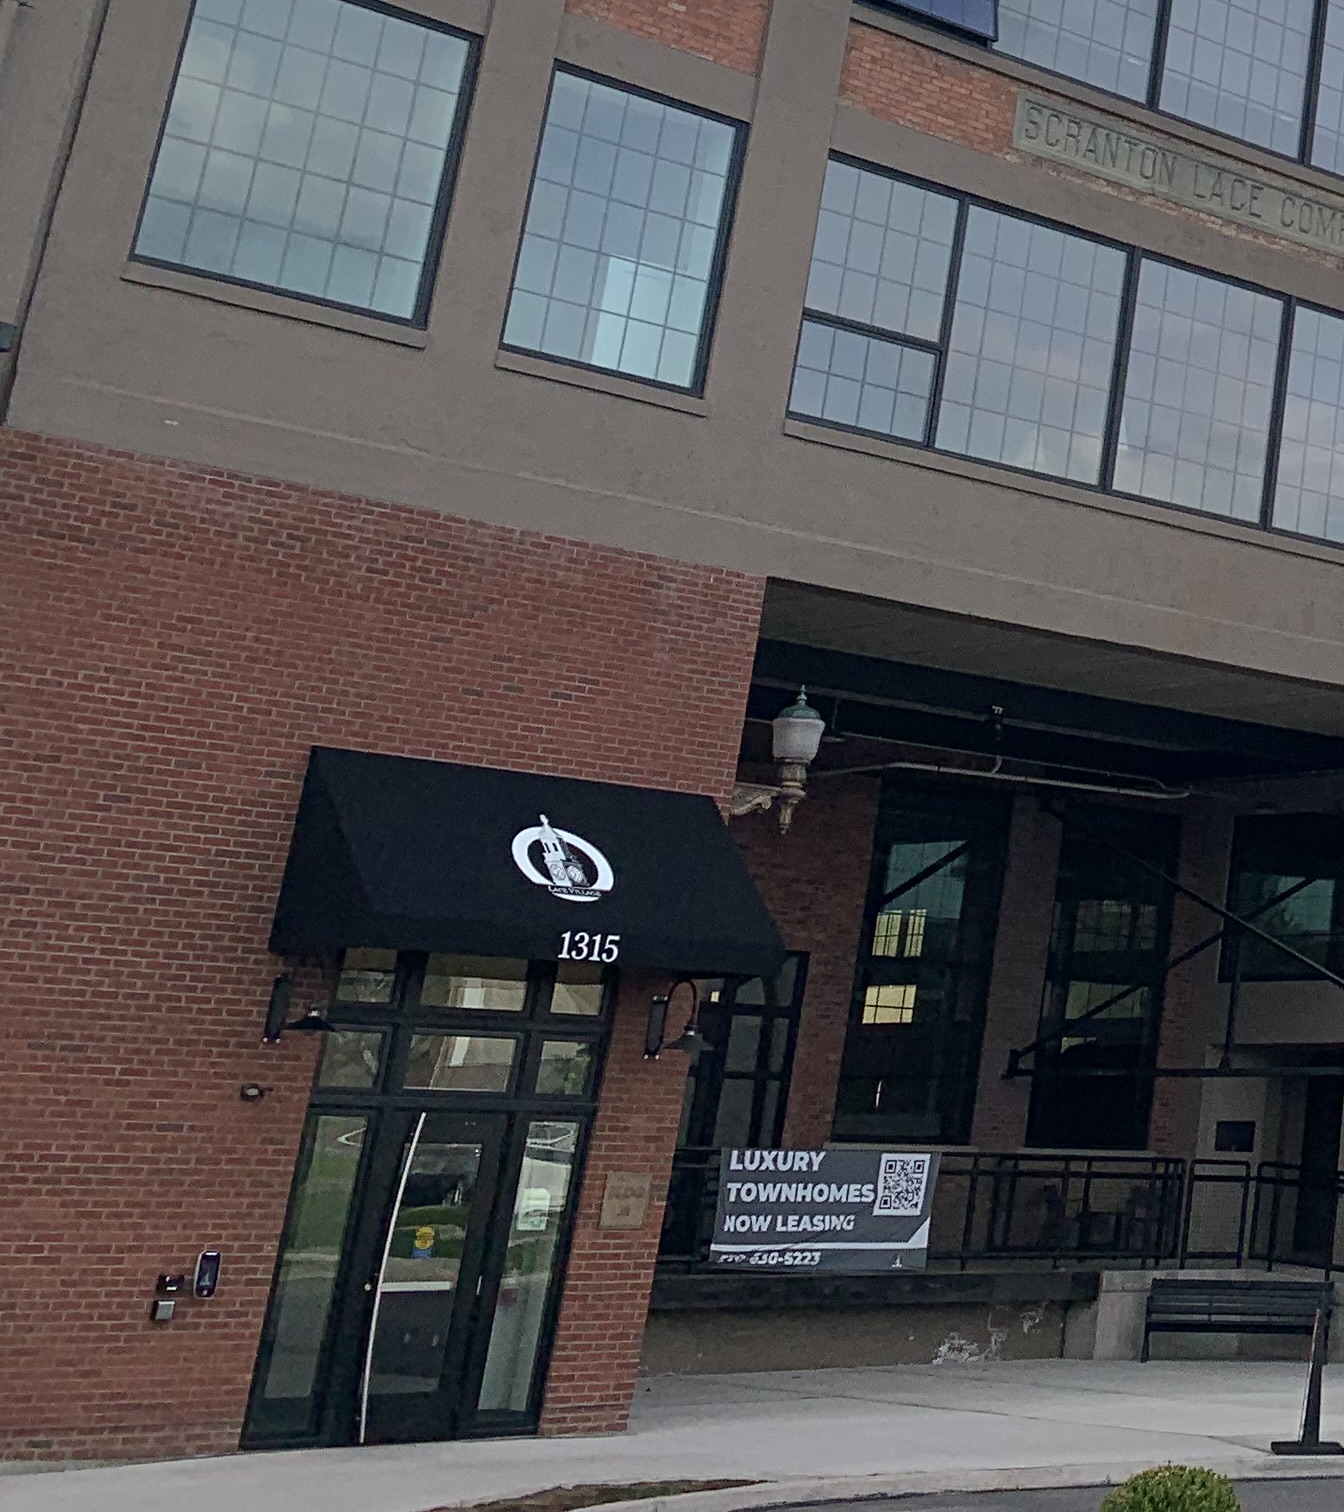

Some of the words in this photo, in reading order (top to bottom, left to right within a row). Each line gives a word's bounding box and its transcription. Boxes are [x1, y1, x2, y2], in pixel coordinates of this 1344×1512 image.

[1024, 105, 1178, 188] SCRANTON
[1194, 159, 1266, 219] LACE
[557, 930, 621, 963] 1315
[729, 1149, 826, 1172] LUXURY
[726, 1182, 876, 1204] TOWNHOMES
[723, 1214, 772, 1233] NOW
[775, 1214, 856, 1232] LEASING
